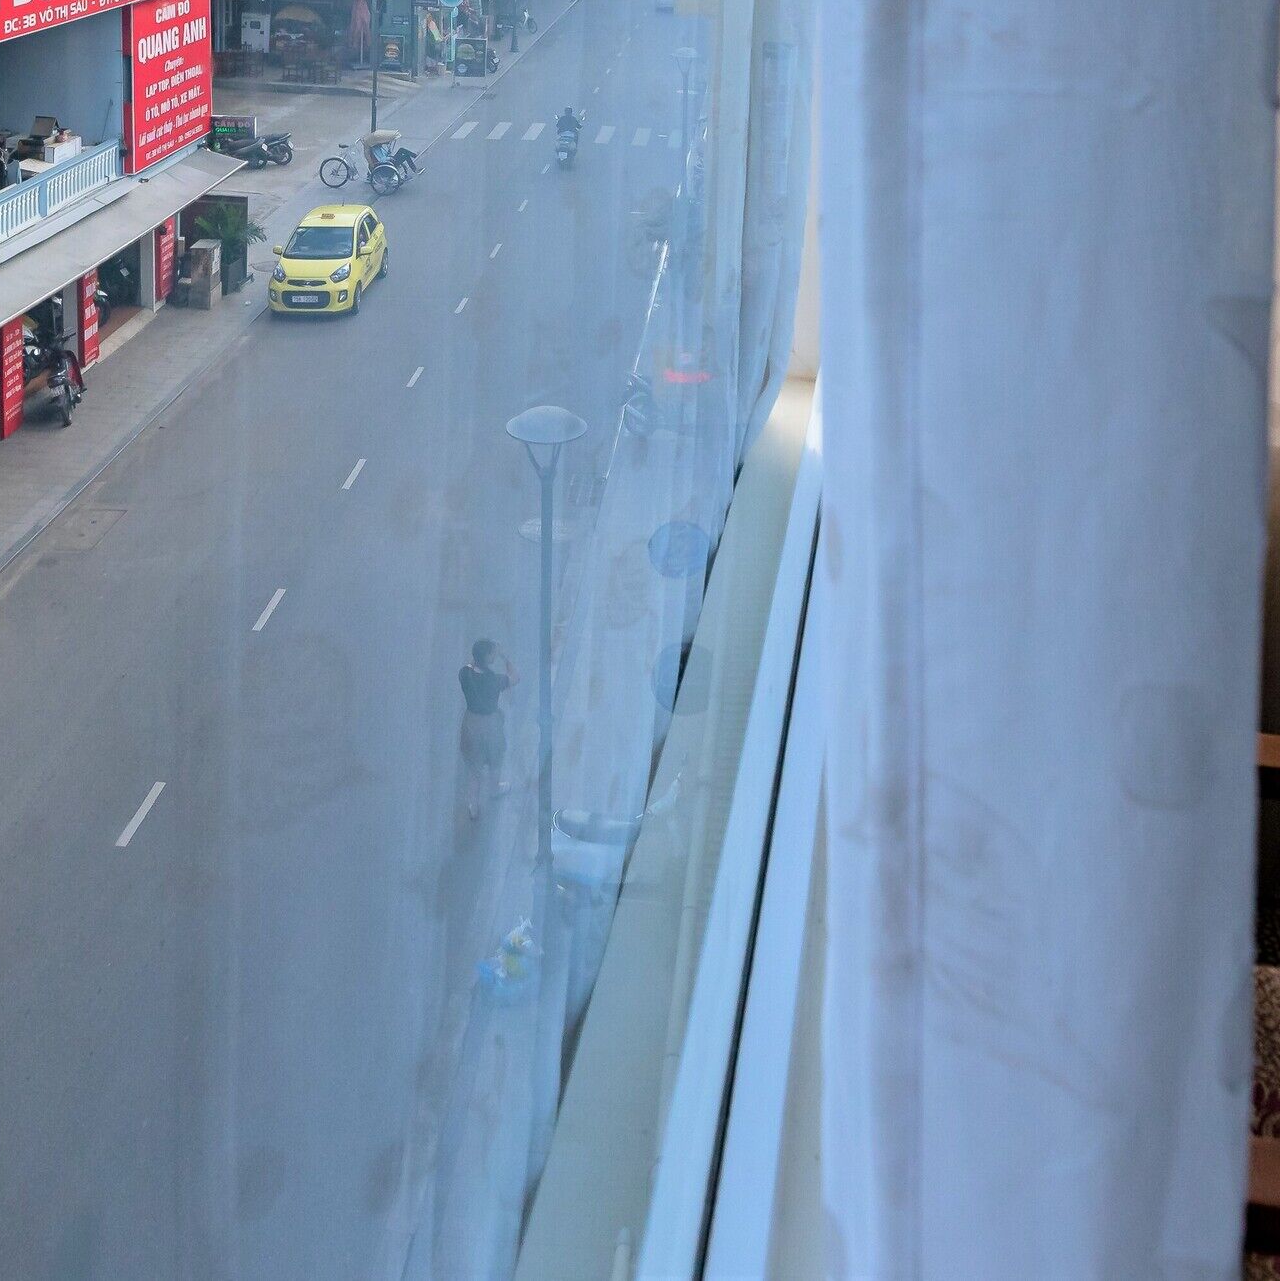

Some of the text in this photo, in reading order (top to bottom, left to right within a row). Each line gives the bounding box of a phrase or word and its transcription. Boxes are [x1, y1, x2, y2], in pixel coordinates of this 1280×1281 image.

[22, 14, 36, 28] 38
[138, 16, 207, 64] QUANG ANH
